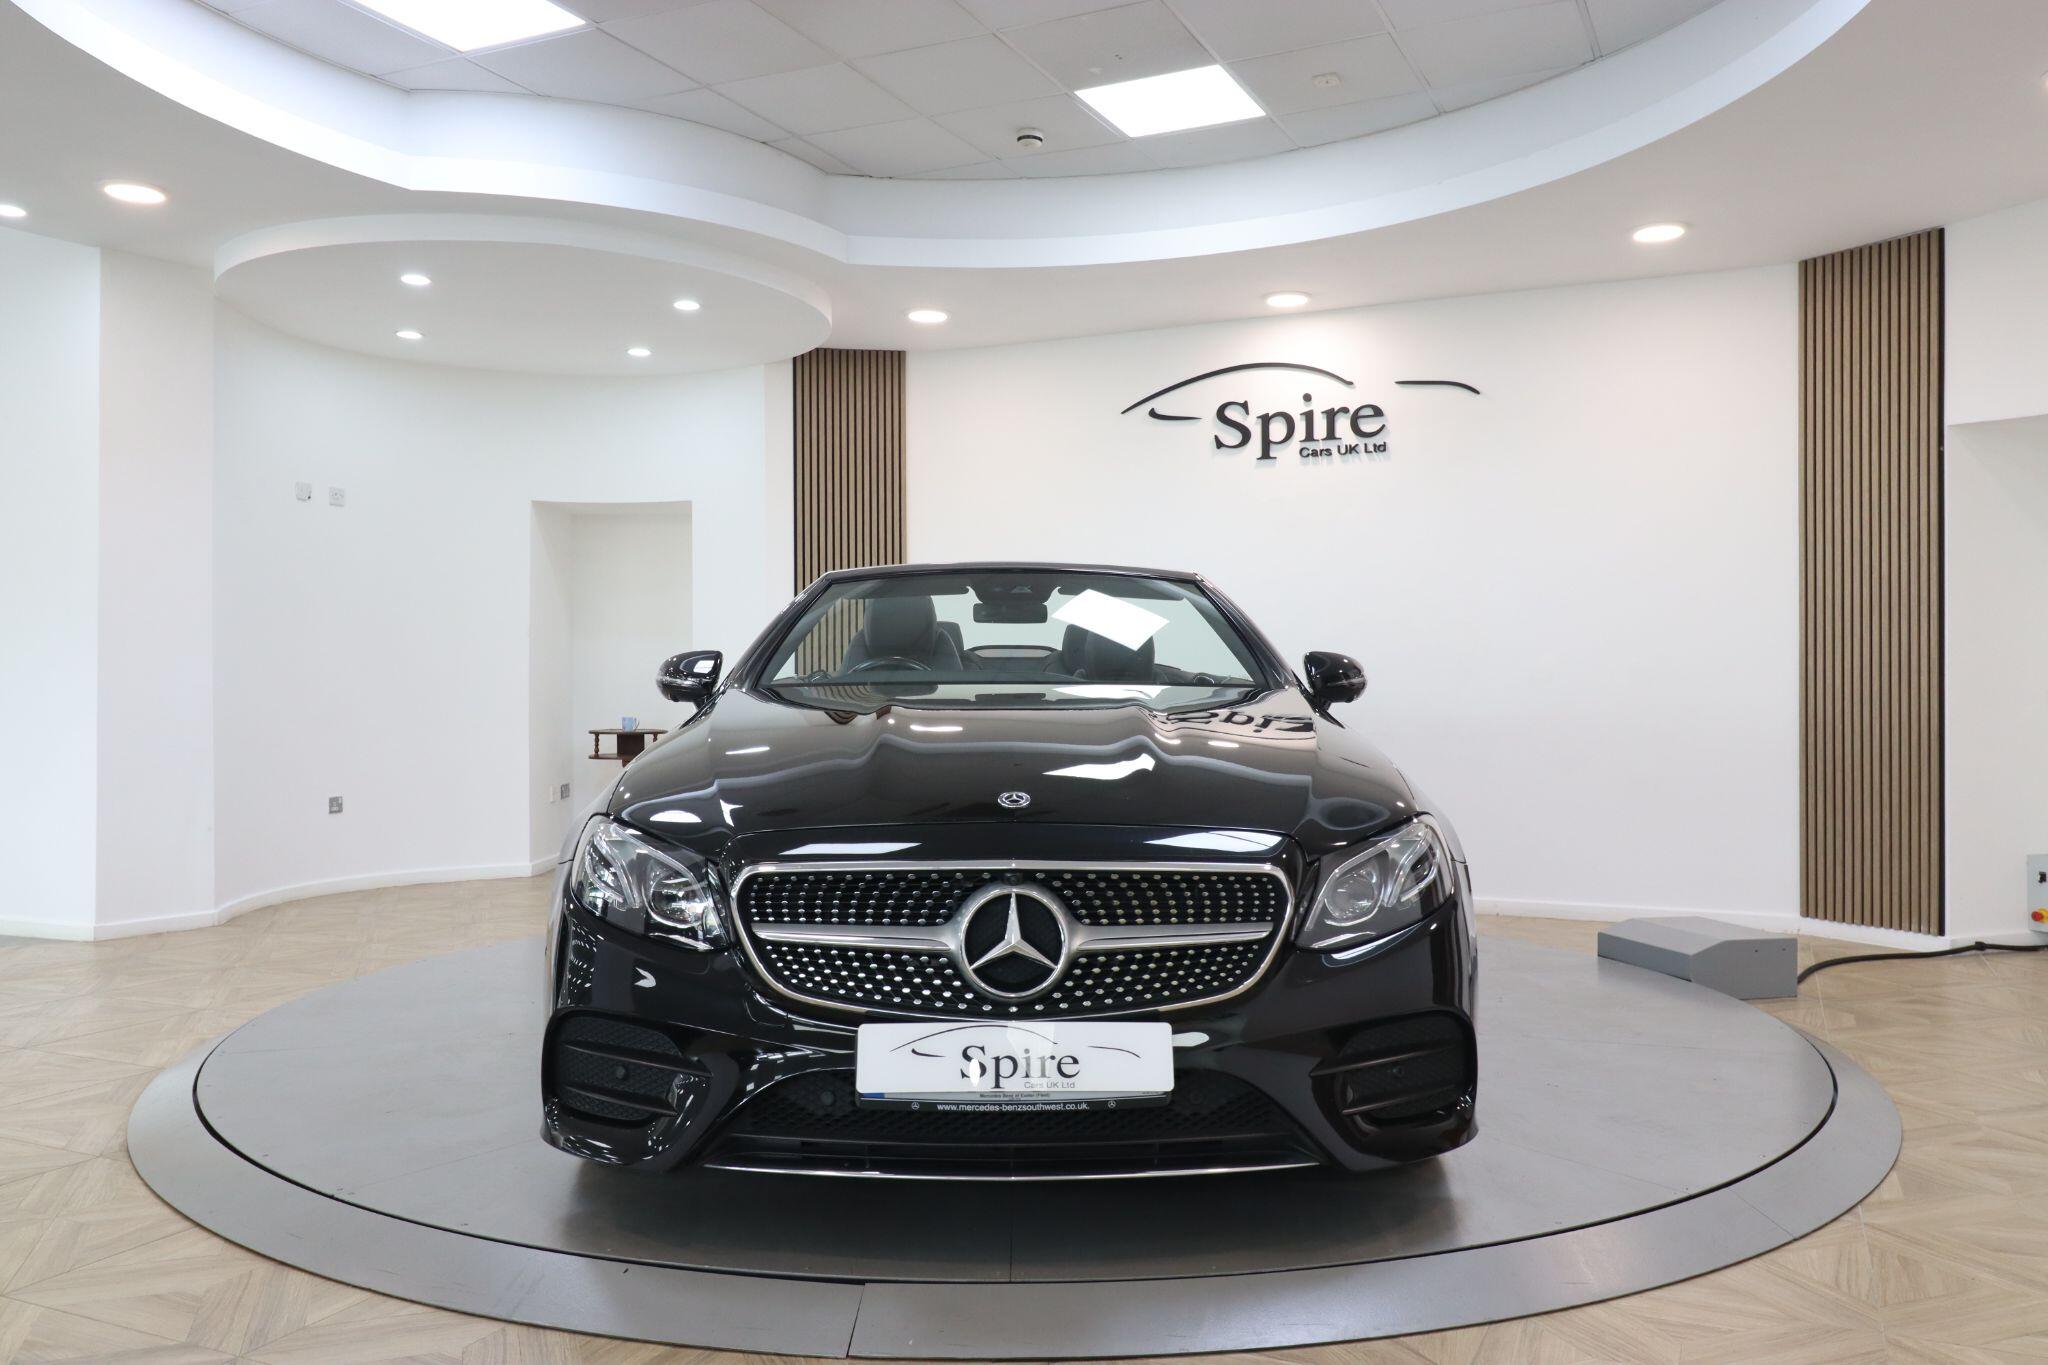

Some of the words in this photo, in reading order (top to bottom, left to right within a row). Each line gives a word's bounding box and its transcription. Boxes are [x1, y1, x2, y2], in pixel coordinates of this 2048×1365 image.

[1214, 393, 1386, 460] Spire
[1299, 446, 1333, 458] Cars
[1337, 443, 1360, 456] UK
[1364, 441, 1387, 454] Ltd
[960, 1045, 1080, 1089] Spire
[1046, 1081, 1060, 1089] UK
[1061, 1081, 1076, 1089] Ltd
